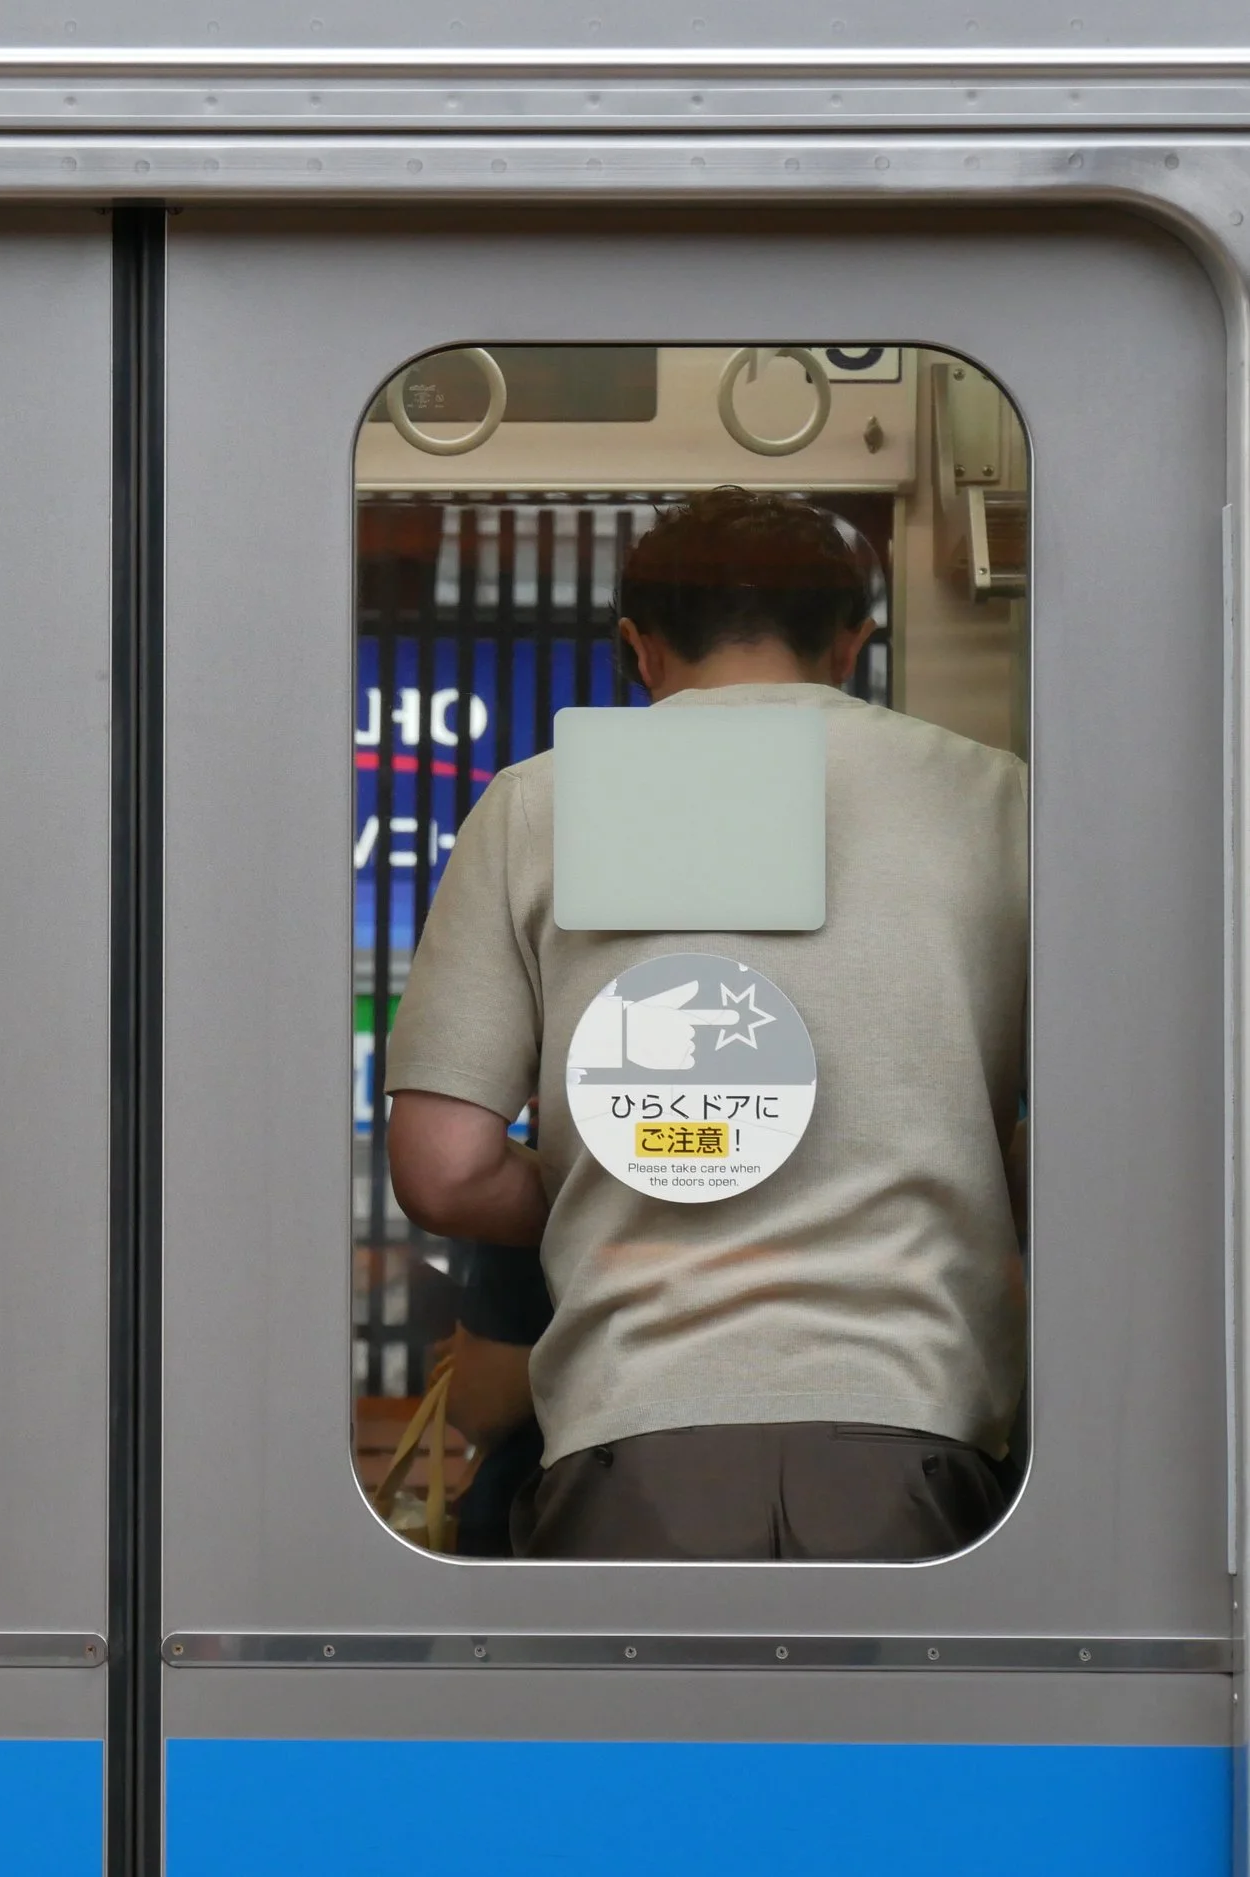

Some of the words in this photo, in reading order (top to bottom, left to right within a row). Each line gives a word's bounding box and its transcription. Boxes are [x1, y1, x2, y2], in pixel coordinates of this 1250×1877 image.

[611, 1094, 779, 1120] ひらくドアに
[627, 1162, 667, 1174] Please
[671, 1163, 697, 1174] take
[701, 1165, 726, 1174] care
[730, 1163, 761, 1174] when
[650, 1176, 668, 1187] the
[672, 1176, 705, 1187] doors
[708, 1178, 739, 1188] open.
